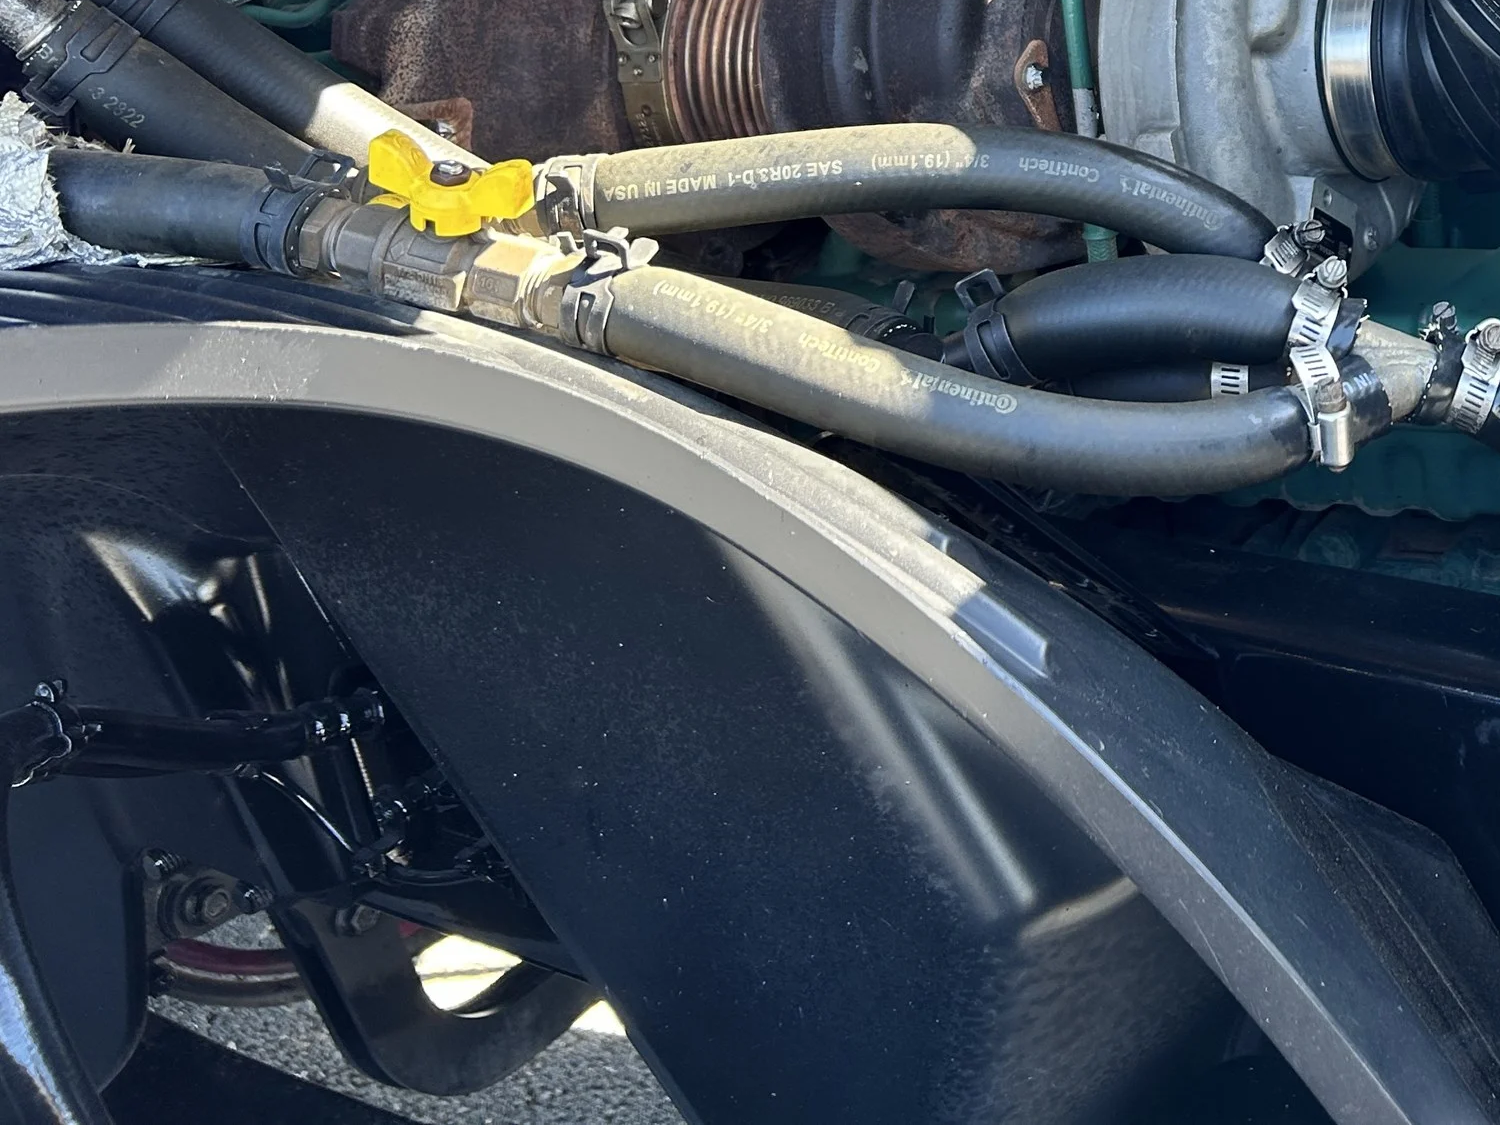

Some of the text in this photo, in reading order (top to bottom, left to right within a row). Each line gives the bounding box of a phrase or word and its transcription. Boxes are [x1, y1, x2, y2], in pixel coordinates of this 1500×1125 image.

[807, 160, 842, 179] SAE
[871, 150, 951, 171] (19.1mm)
[1019, 157, 1100, 183] ContiTech
[602, 183, 639, 202] USA
[644, 180, 661, 197] IN
[666, 174, 718, 195] MADE
[1132, 176, 1224, 231] Continental
[798, 331, 882, 373] ContiTech
[911, 372, 1018, 414] Continental
